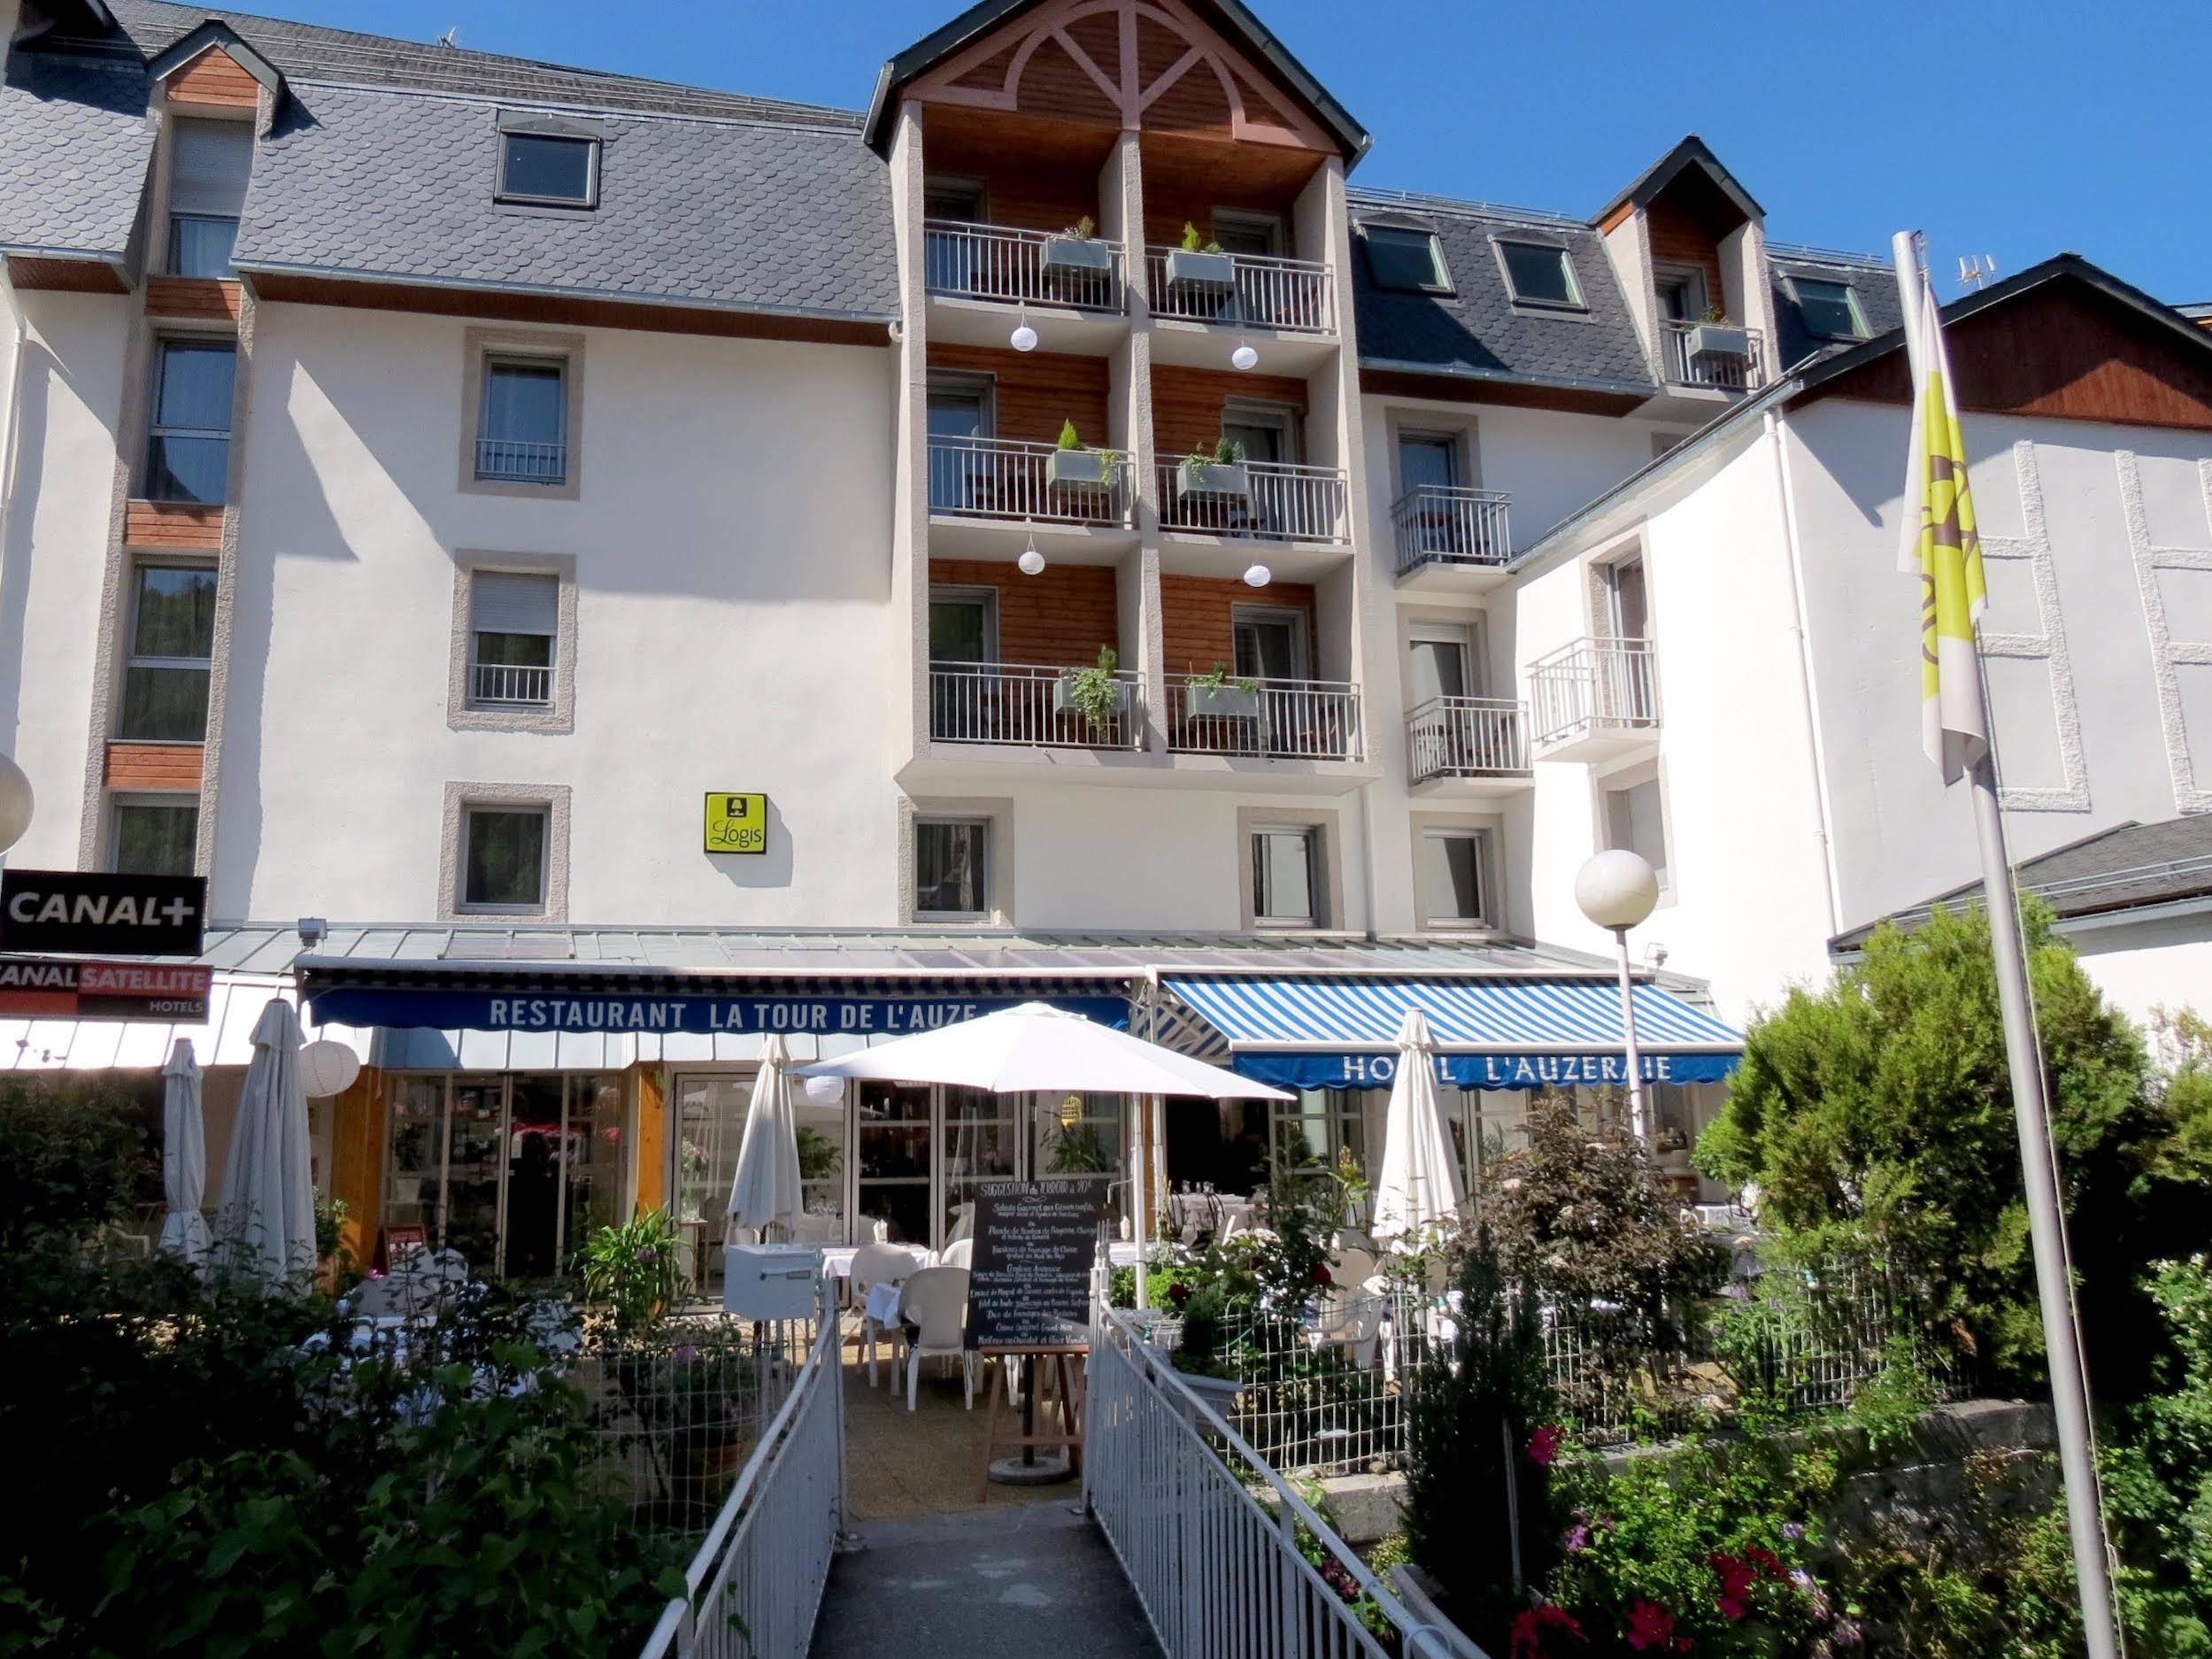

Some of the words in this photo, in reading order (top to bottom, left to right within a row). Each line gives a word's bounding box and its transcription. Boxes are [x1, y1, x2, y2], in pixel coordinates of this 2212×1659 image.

[710, 819, 762, 848] Logis
[9, 891, 195, 927] CANAL+
[0, 965, 78, 988] ANAL
[80, 968, 204, 992] SATELLITE
[150, 1001, 204, 1014] HOTELS
[490, 999, 687, 1028] RESTAURANT
[710, 1004, 744, 1029] LA
[754, 1004, 827, 1029] TOUR
[841, 1004, 874, 1029] DE
[1343, 1056, 1460, 1081] HOL
[981, 1182, 1029, 1197] SUGGESTION
